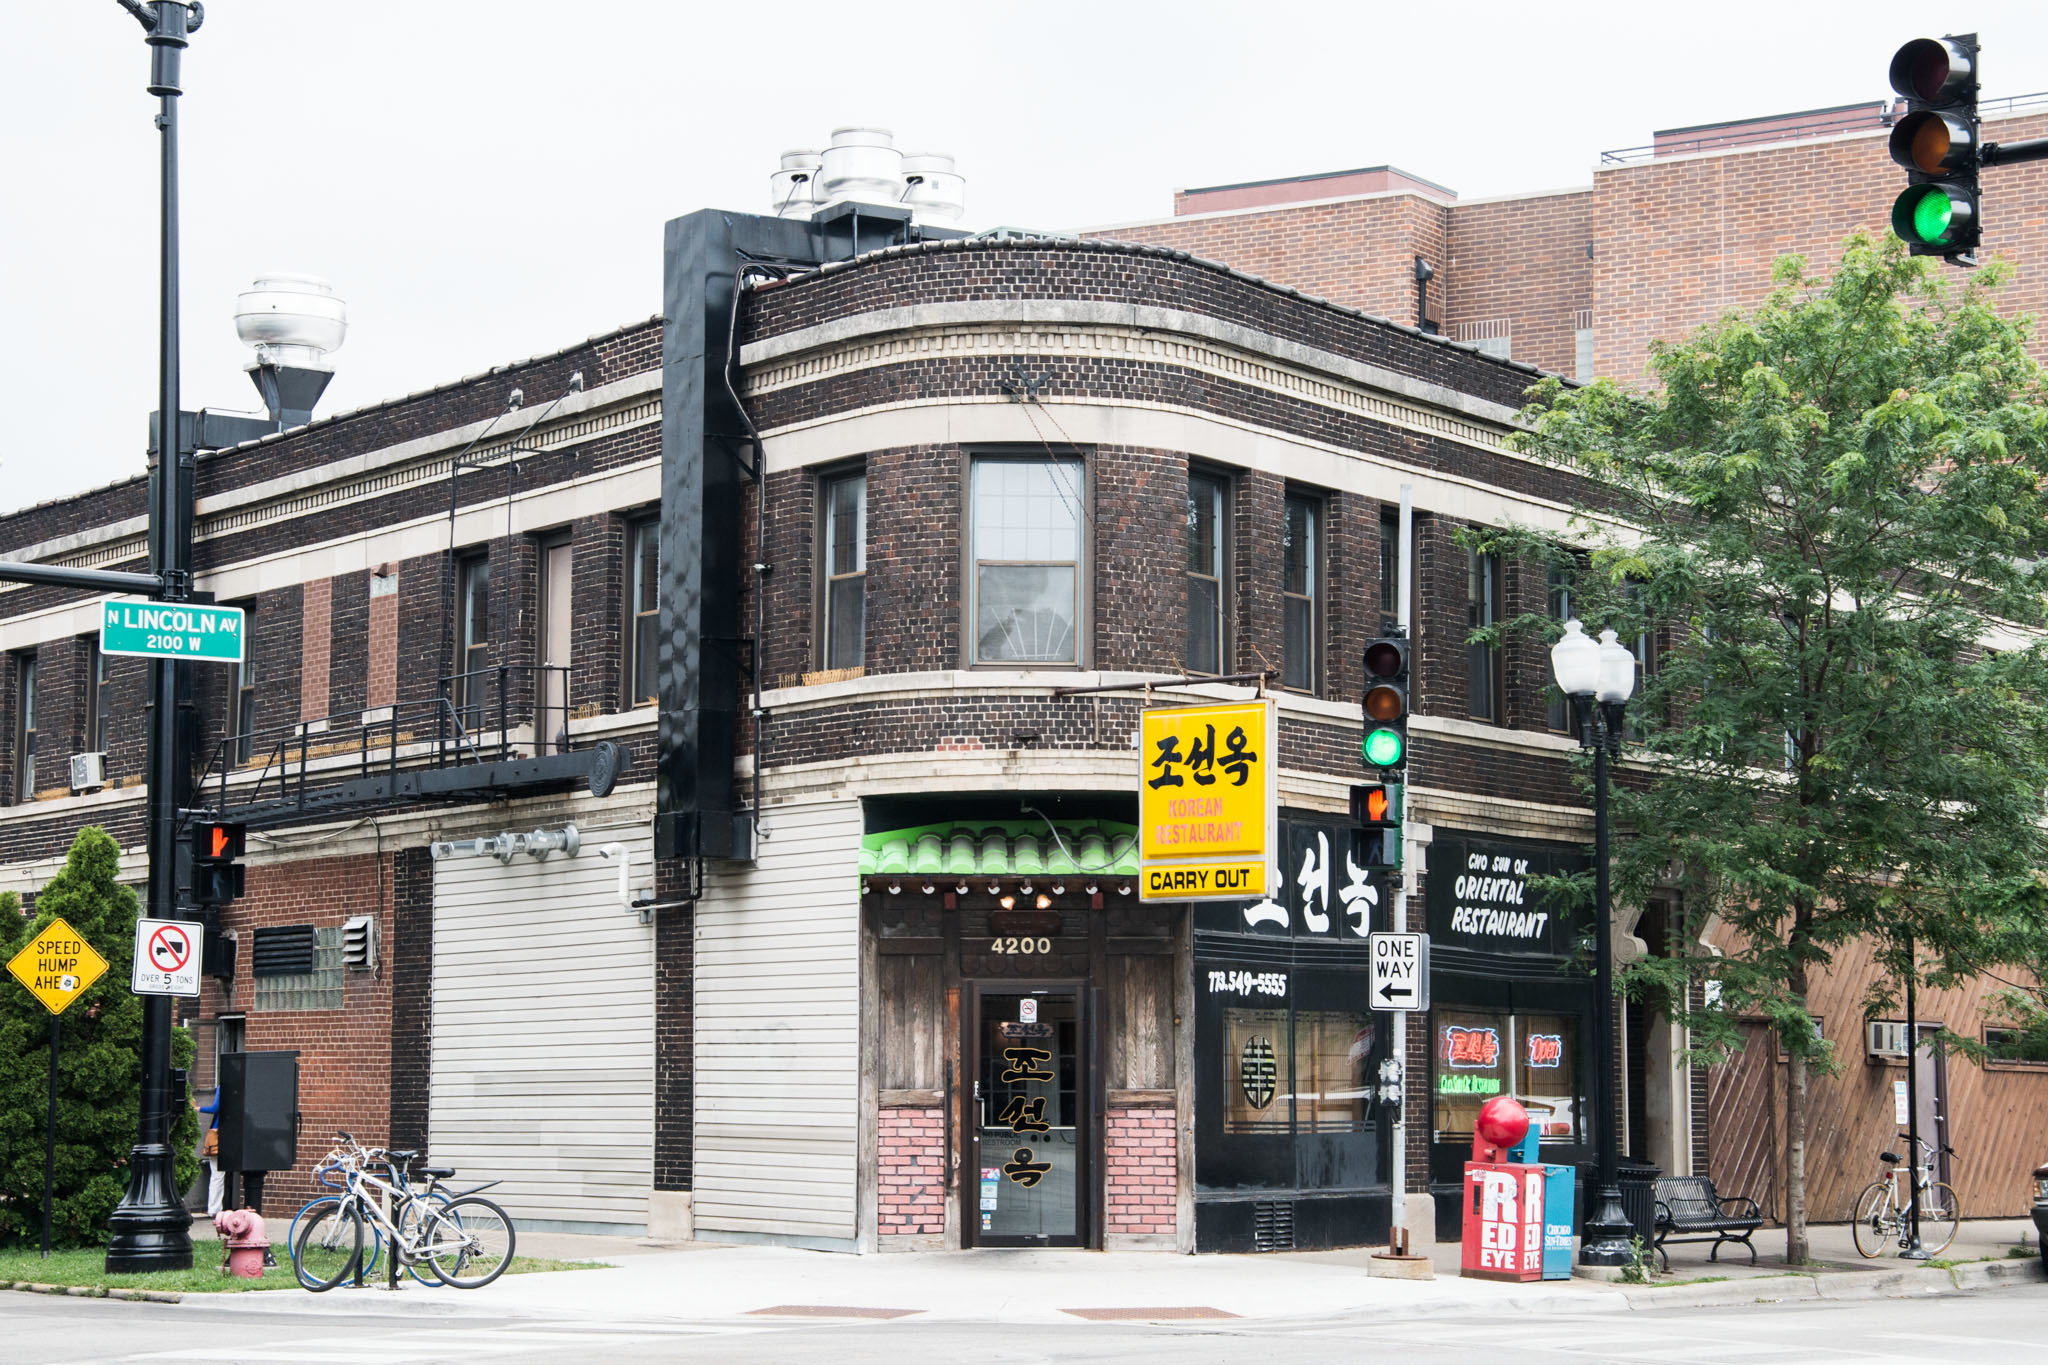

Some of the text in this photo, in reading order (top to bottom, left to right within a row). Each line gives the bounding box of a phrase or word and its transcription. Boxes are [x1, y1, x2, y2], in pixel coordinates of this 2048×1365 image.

[107, 608, 238, 634] N LINCOLN AV
[146, 634, 201, 651] 2100 W
[1148, 724, 1258, 790] 조선옥
[1168, 797, 1223, 819] KOREAN
[1155, 821, 1243, 845] RESTAURANT
[1468, 852, 1529, 875] CHO SUN OK
[1150, 868, 1250, 891] CARRY OUT
[1454, 875, 1524, 905] ORIENTAL
[1451, 906, 1549, 939] RESTAURANT
[36, 941, 81, 955] SPEED
[991, 936, 1052, 955] 4200
[1377, 940, 1414, 957] ONE
[38, 958, 78, 973] HUMP
[1376, 961, 1415, 978] WAY
[34, 976, 81, 990] AHED
[141, 973, 193, 984] OVER 5 TONS
[1480, 1248, 1516, 1270] EYE
[1523, 1250, 1541, 1270] EYE
